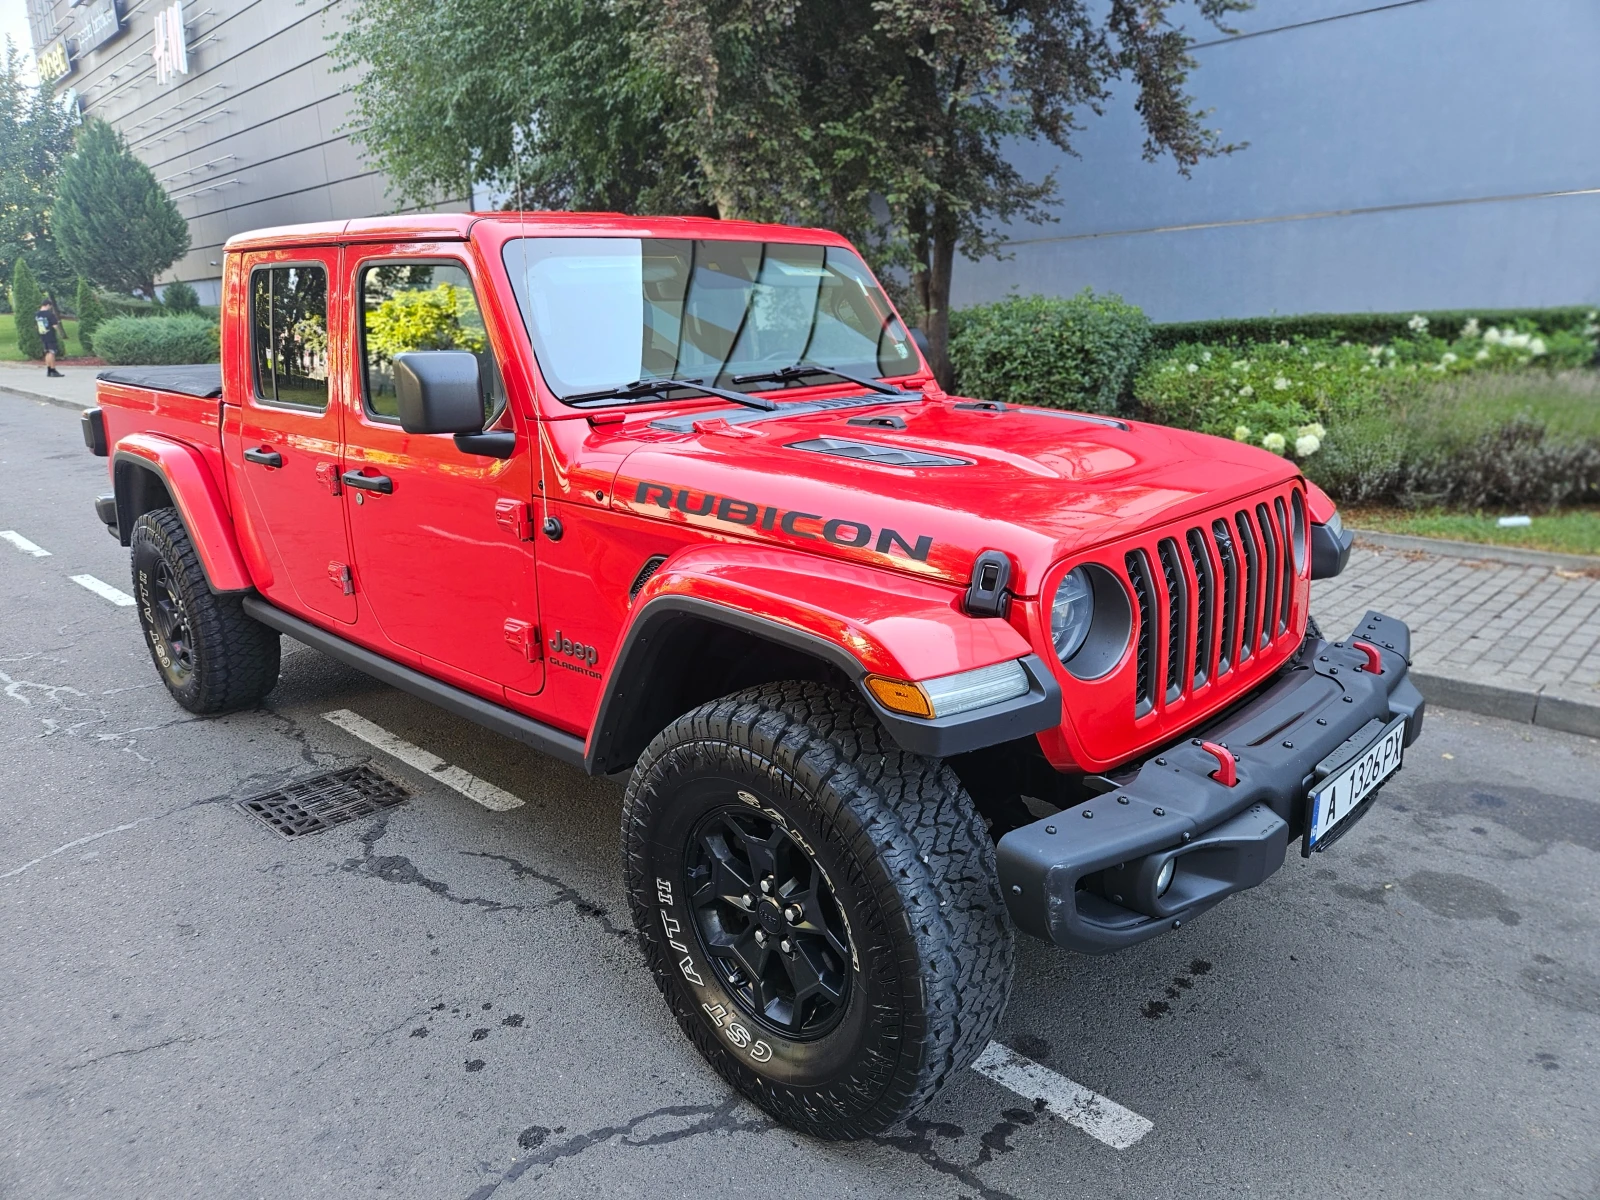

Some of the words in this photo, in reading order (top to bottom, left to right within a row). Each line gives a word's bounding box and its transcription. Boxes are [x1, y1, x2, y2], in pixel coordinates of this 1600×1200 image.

[634, 482, 934, 561] RUBICON
[549, 629, 599, 668] Jeep
[549, 656, 603, 681] GLADIATOR
[1325, 786, 1336, 826] A
[1348, 745, 1381, 805] 1326
[1381, 727, 1404, 774] PX
[660, 908, 705, 987] A/T
[702, 1002, 774, 1064] CST
